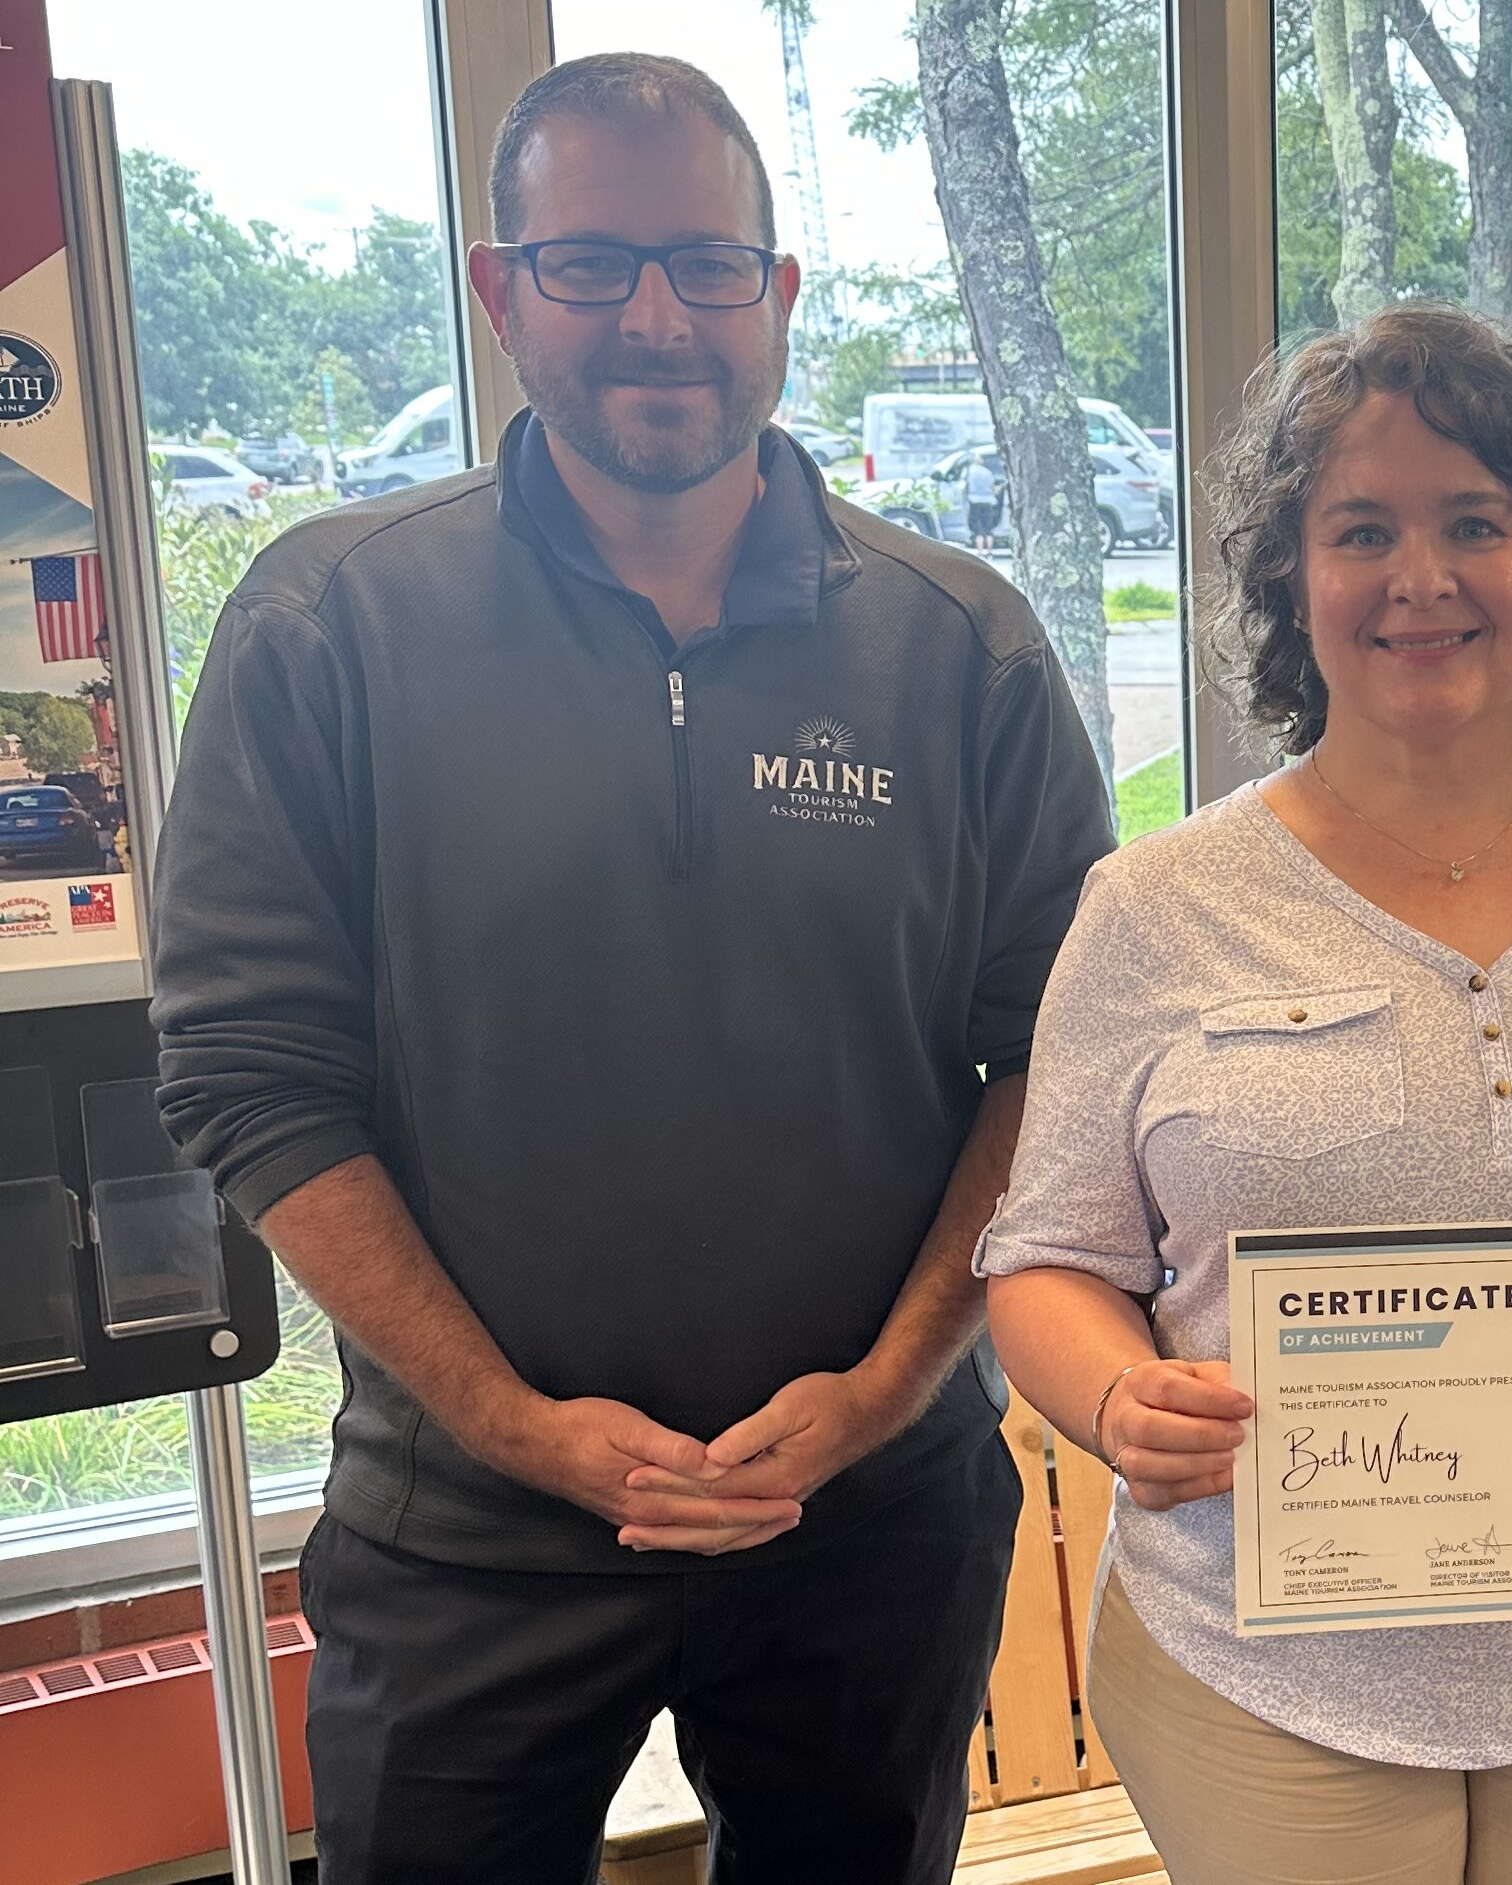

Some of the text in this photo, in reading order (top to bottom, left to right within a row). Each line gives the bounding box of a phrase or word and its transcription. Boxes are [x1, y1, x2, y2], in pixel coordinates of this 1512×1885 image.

[0, 376, 45, 401] TH
[752, 753, 894, 805] MAINE
[788, 792, 859, 810] TOURISM
[770, 804, 876, 828] ASSOCIATION
[1283, 1329, 1425, 1347] OF ACHIEVEMENT
[1280, 1384, 1314, 1395] MAINE
[1316, 1382, 1364, 1393] TOURISM
[1366, 1379, 1436, 1391] ASSOCIATION
[1438, 1376, 1487, 1388] PROUDLY
[1280, 1398, 1388, 1411] THIS CERTIFICATE TO
[1281, 1412, 1463, 1492] Beth Whitney
[1282, 1492, 1491, 1512] CERTIFIED MAINE TRAVEL COUNSELOR
[1283, 1566, 1349, 1578] TONY CAMERON
[1430, 1558, 1496, 1568] JANE ANDERSON
[1284, 1577, 1383, 1590] CHIEF EXECUTIVE OFFICER
[1430, 1572, 1468, 1581] DIRECTOR
[1469, 1571, 1480, 1579] OF
[1430, 1579, 1455, 1588] MAINE
[1457, 1578, 1490, 1587] TOURISM
[1284, 1583, 1398, 1597] MAINE TOURISM ASSOCIATION
